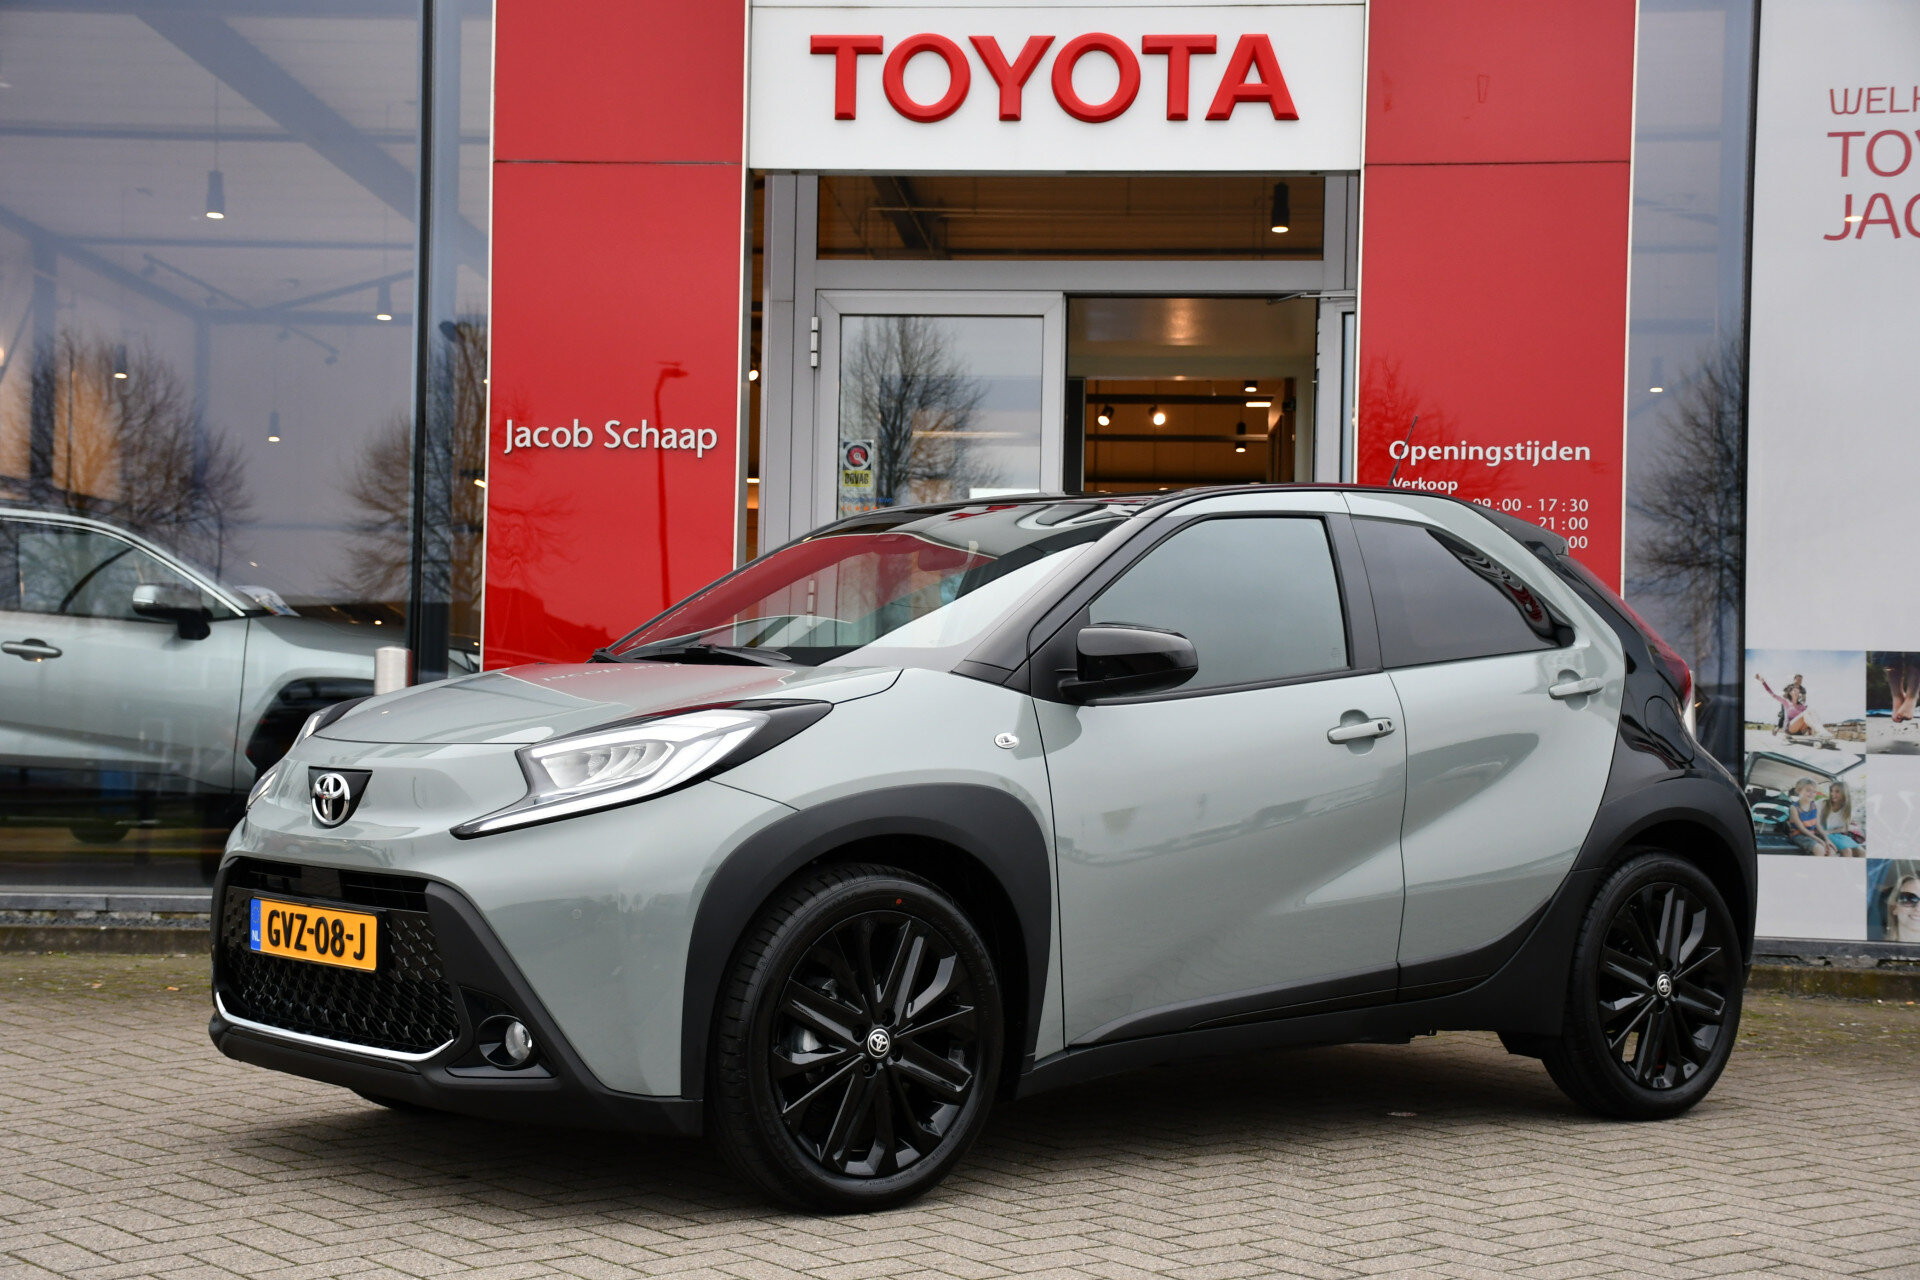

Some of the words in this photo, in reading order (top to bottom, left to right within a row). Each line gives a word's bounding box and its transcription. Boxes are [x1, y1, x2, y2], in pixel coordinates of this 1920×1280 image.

[810, 32, 1300, 123] TOYOTA
[1827, 129, 1920, 178] TO
[503, 418, 594, 454] Jacob
[603, 419, 718, 459] Schaap
[1388, 440, 1591, 467] Openingstijden
[1392, 476, 1459, 495] Verkoop
[1537, 498, 1589, 512] 17:30
[1538, 516, 1589, 531] 21:00
[1567, 535, 1589, 549] 00
[251, 929, 260, 942] NL
[267, 909, 366, 961] GVZ-08-J
